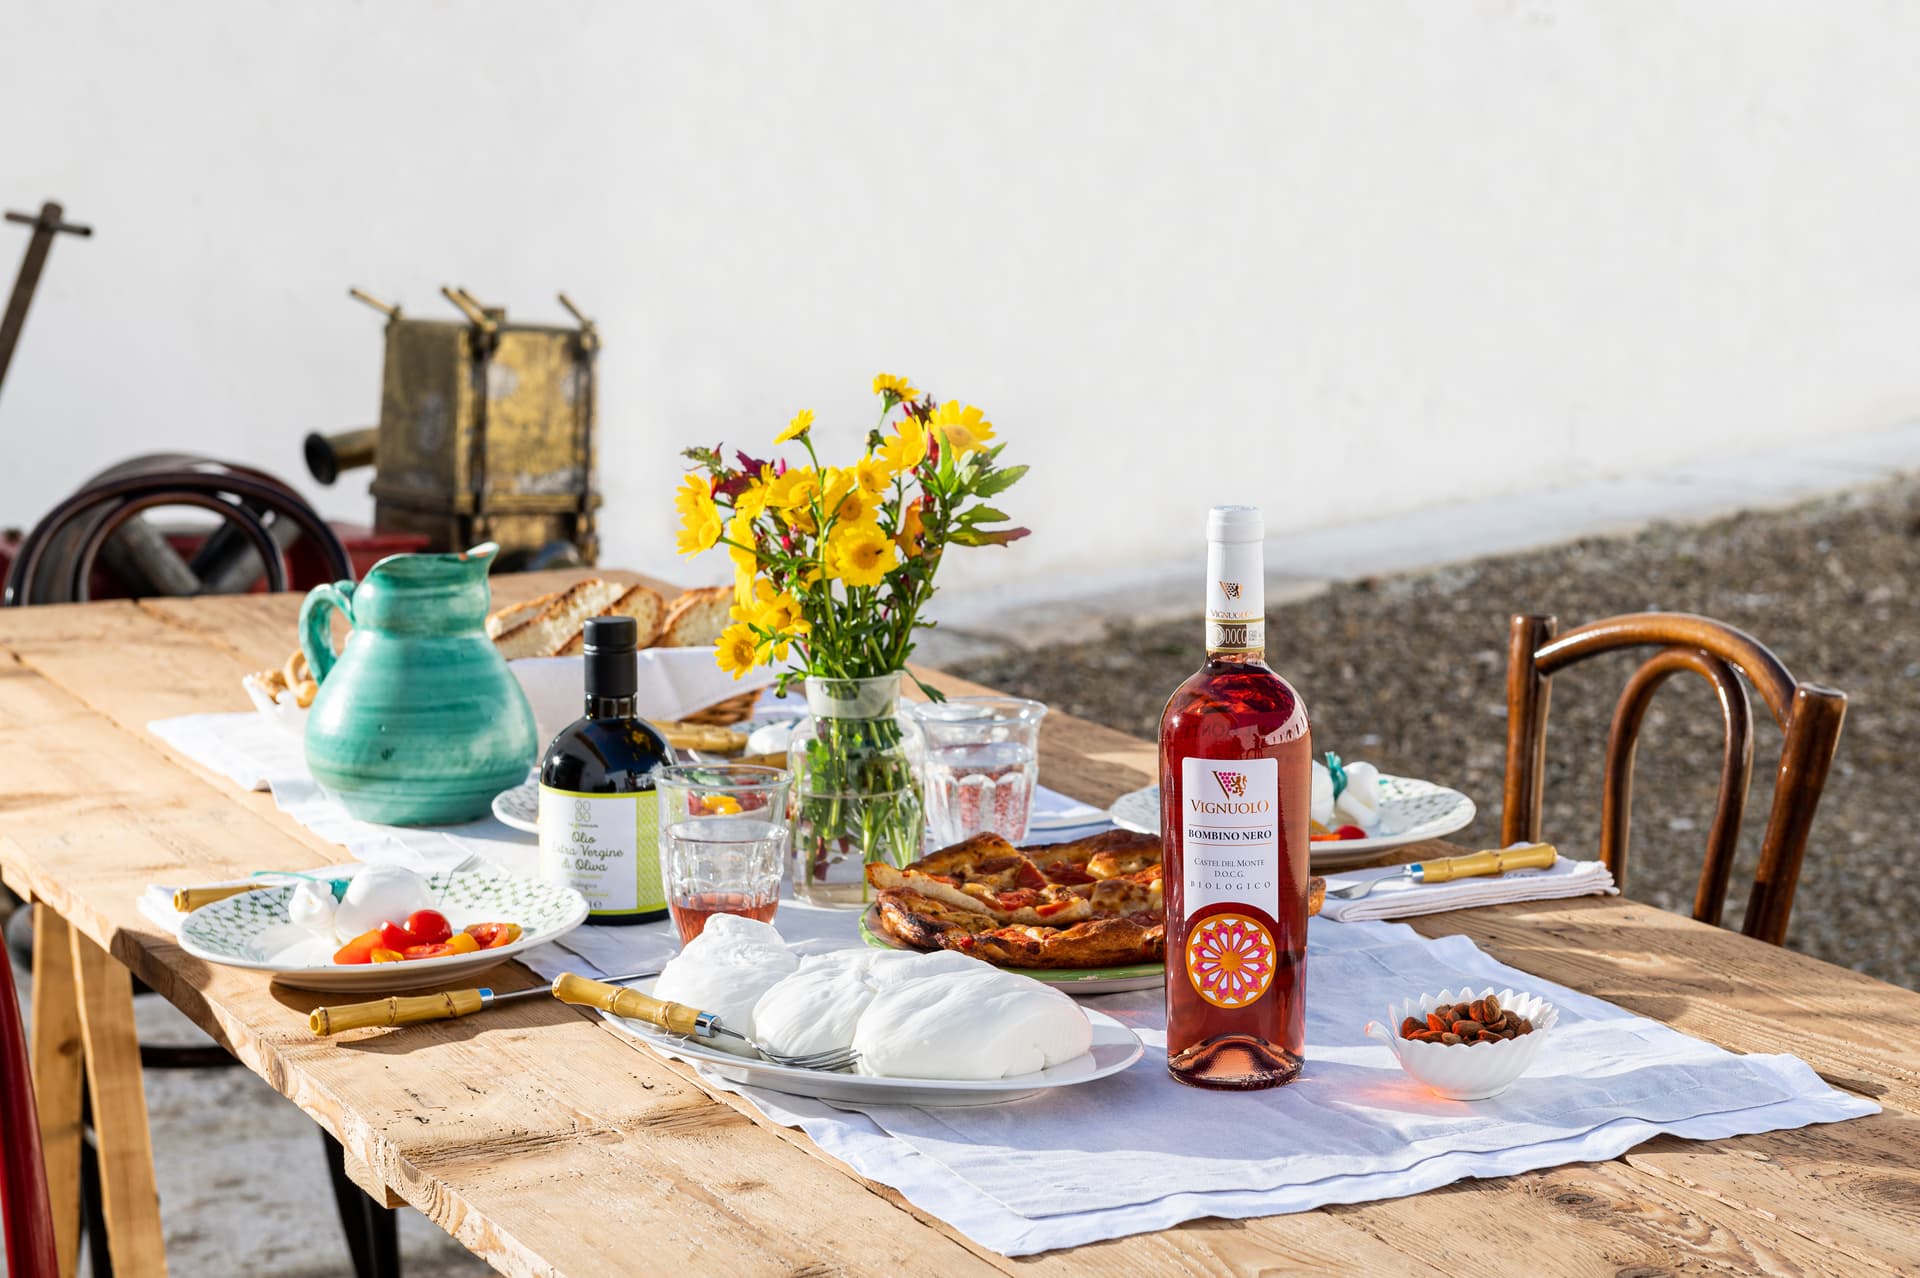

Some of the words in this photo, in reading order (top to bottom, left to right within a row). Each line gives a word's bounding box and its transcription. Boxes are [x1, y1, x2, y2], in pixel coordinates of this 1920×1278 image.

[1191, 799, 1269, 815] VIGNUOLO
[572, 831, 597, 843] Olio
[1188, 829, 1240, 841] BOMBINO
[1242, 829, 1272, 840] NERO
[580, 844, 624, 860] Vergine
[575, 858, 608, 871] Oliva
[1194, 857, 1221, 866] CASTEL
[1236, 859, 1265, 867] MONTE
[1190, 881, 1271, 890] BIOLOGICO
